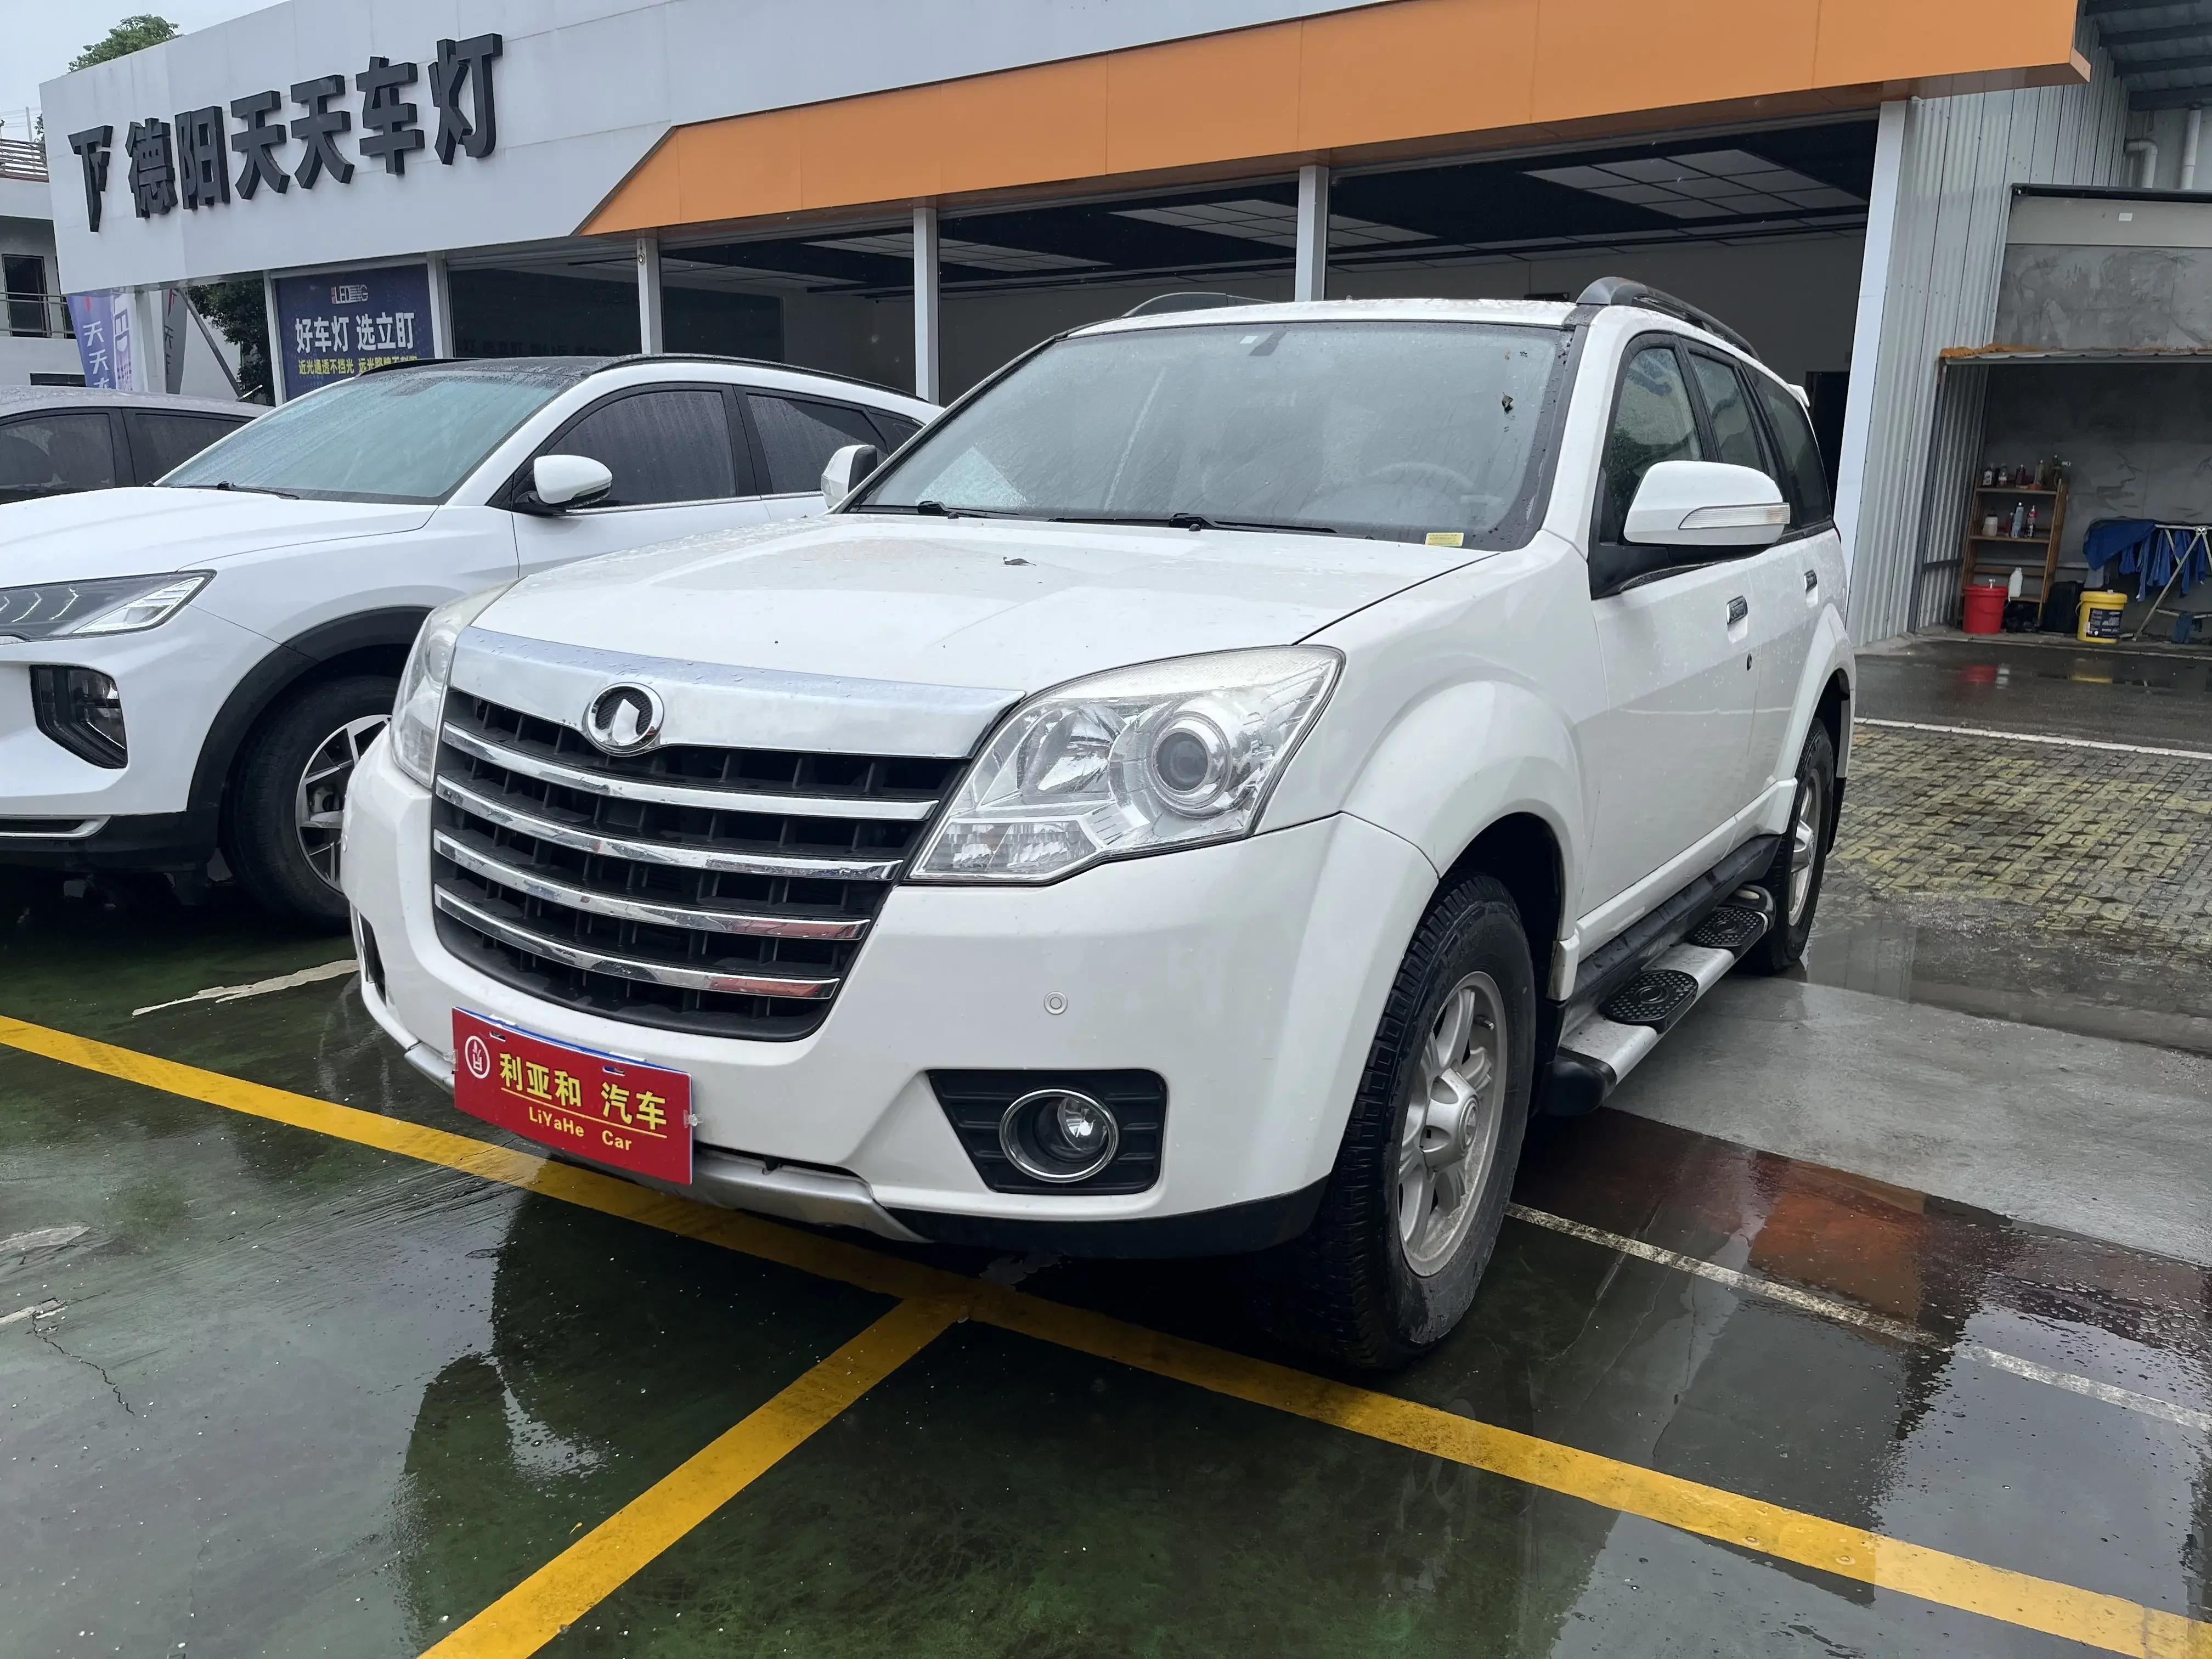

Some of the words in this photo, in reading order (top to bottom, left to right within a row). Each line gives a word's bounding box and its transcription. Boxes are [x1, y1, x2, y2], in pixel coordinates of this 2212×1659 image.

[295, 315, 349, 354] 好车灯
[356, 312, 415, 351] 选立盯
[499, 1052, 582, 1107] 利亚和
[601, 1081, 667, 1130] 汽车
[529, 1106, 585, 1137] LiYaHe
[601, 1130, 633, 1151] Car
